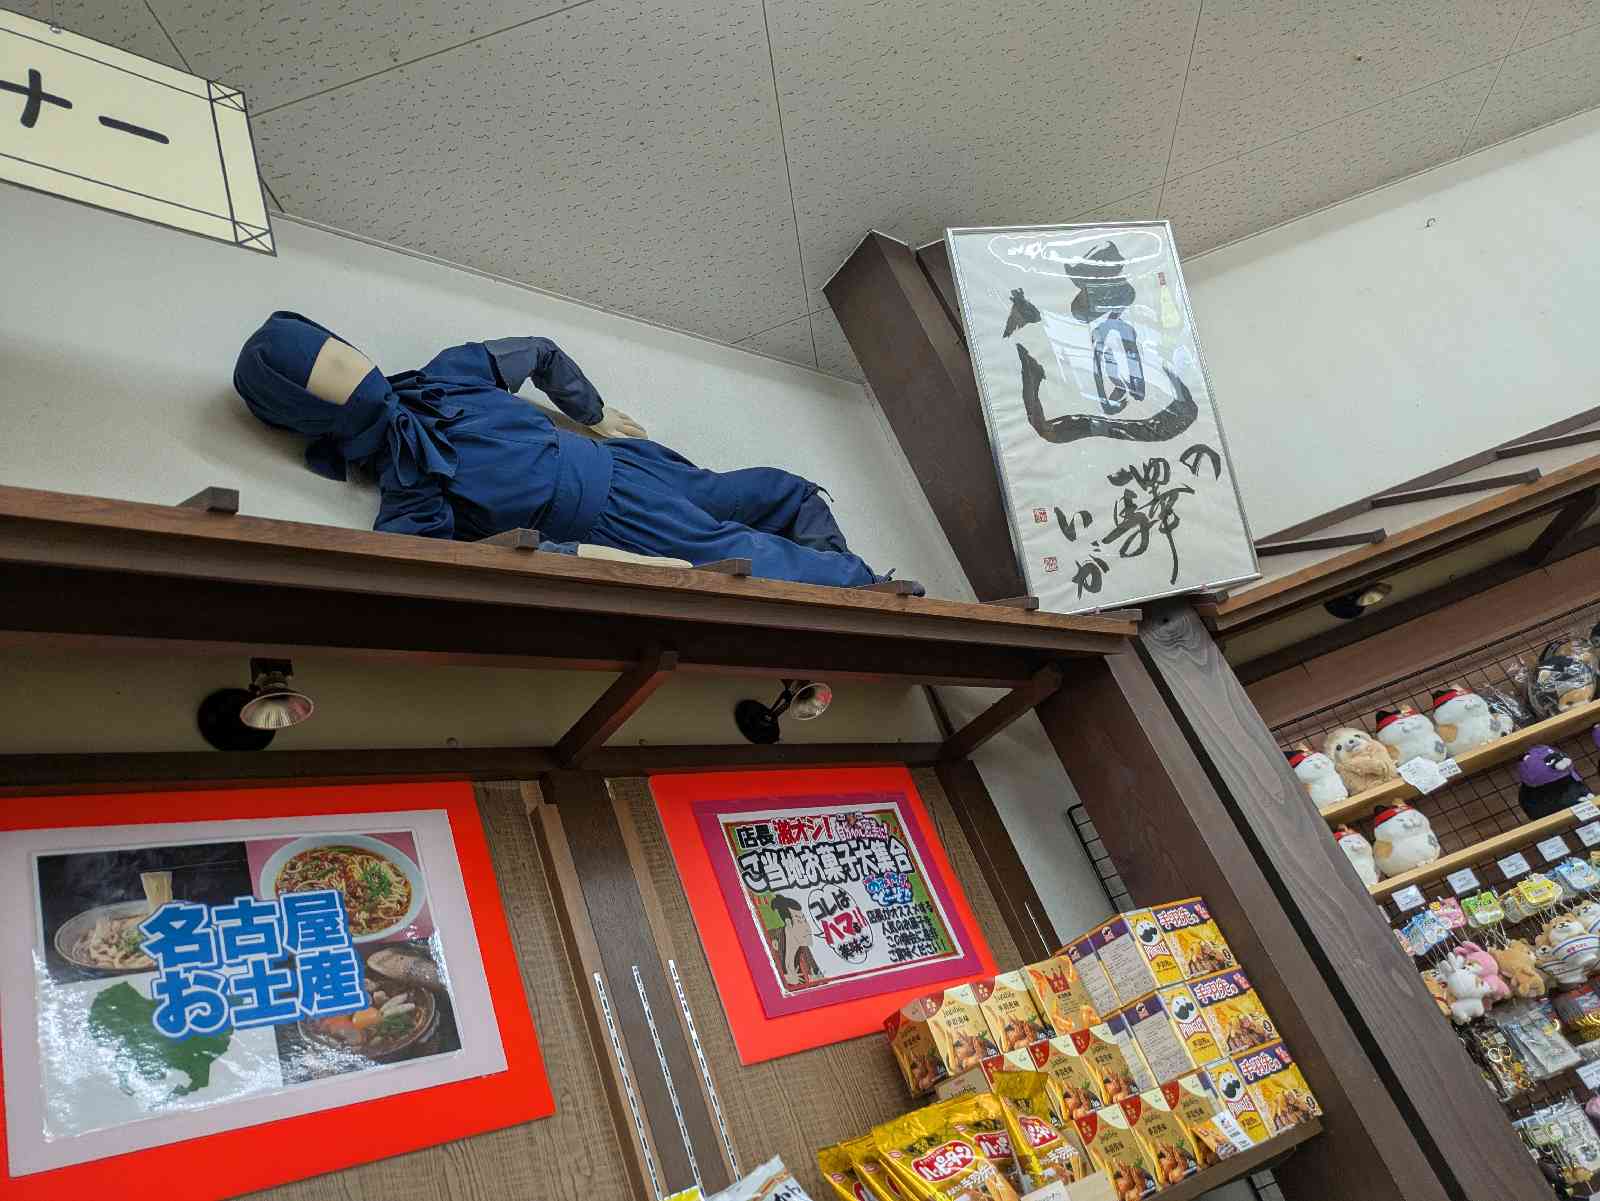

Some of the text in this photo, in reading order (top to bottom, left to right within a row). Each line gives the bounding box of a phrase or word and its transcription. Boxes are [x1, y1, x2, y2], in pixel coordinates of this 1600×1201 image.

[738, 835, 915, 893] ご当地お菓子大集合
[140, 890, 351, 971] 名古屋
[151, 947, 370, 1038] お土産
